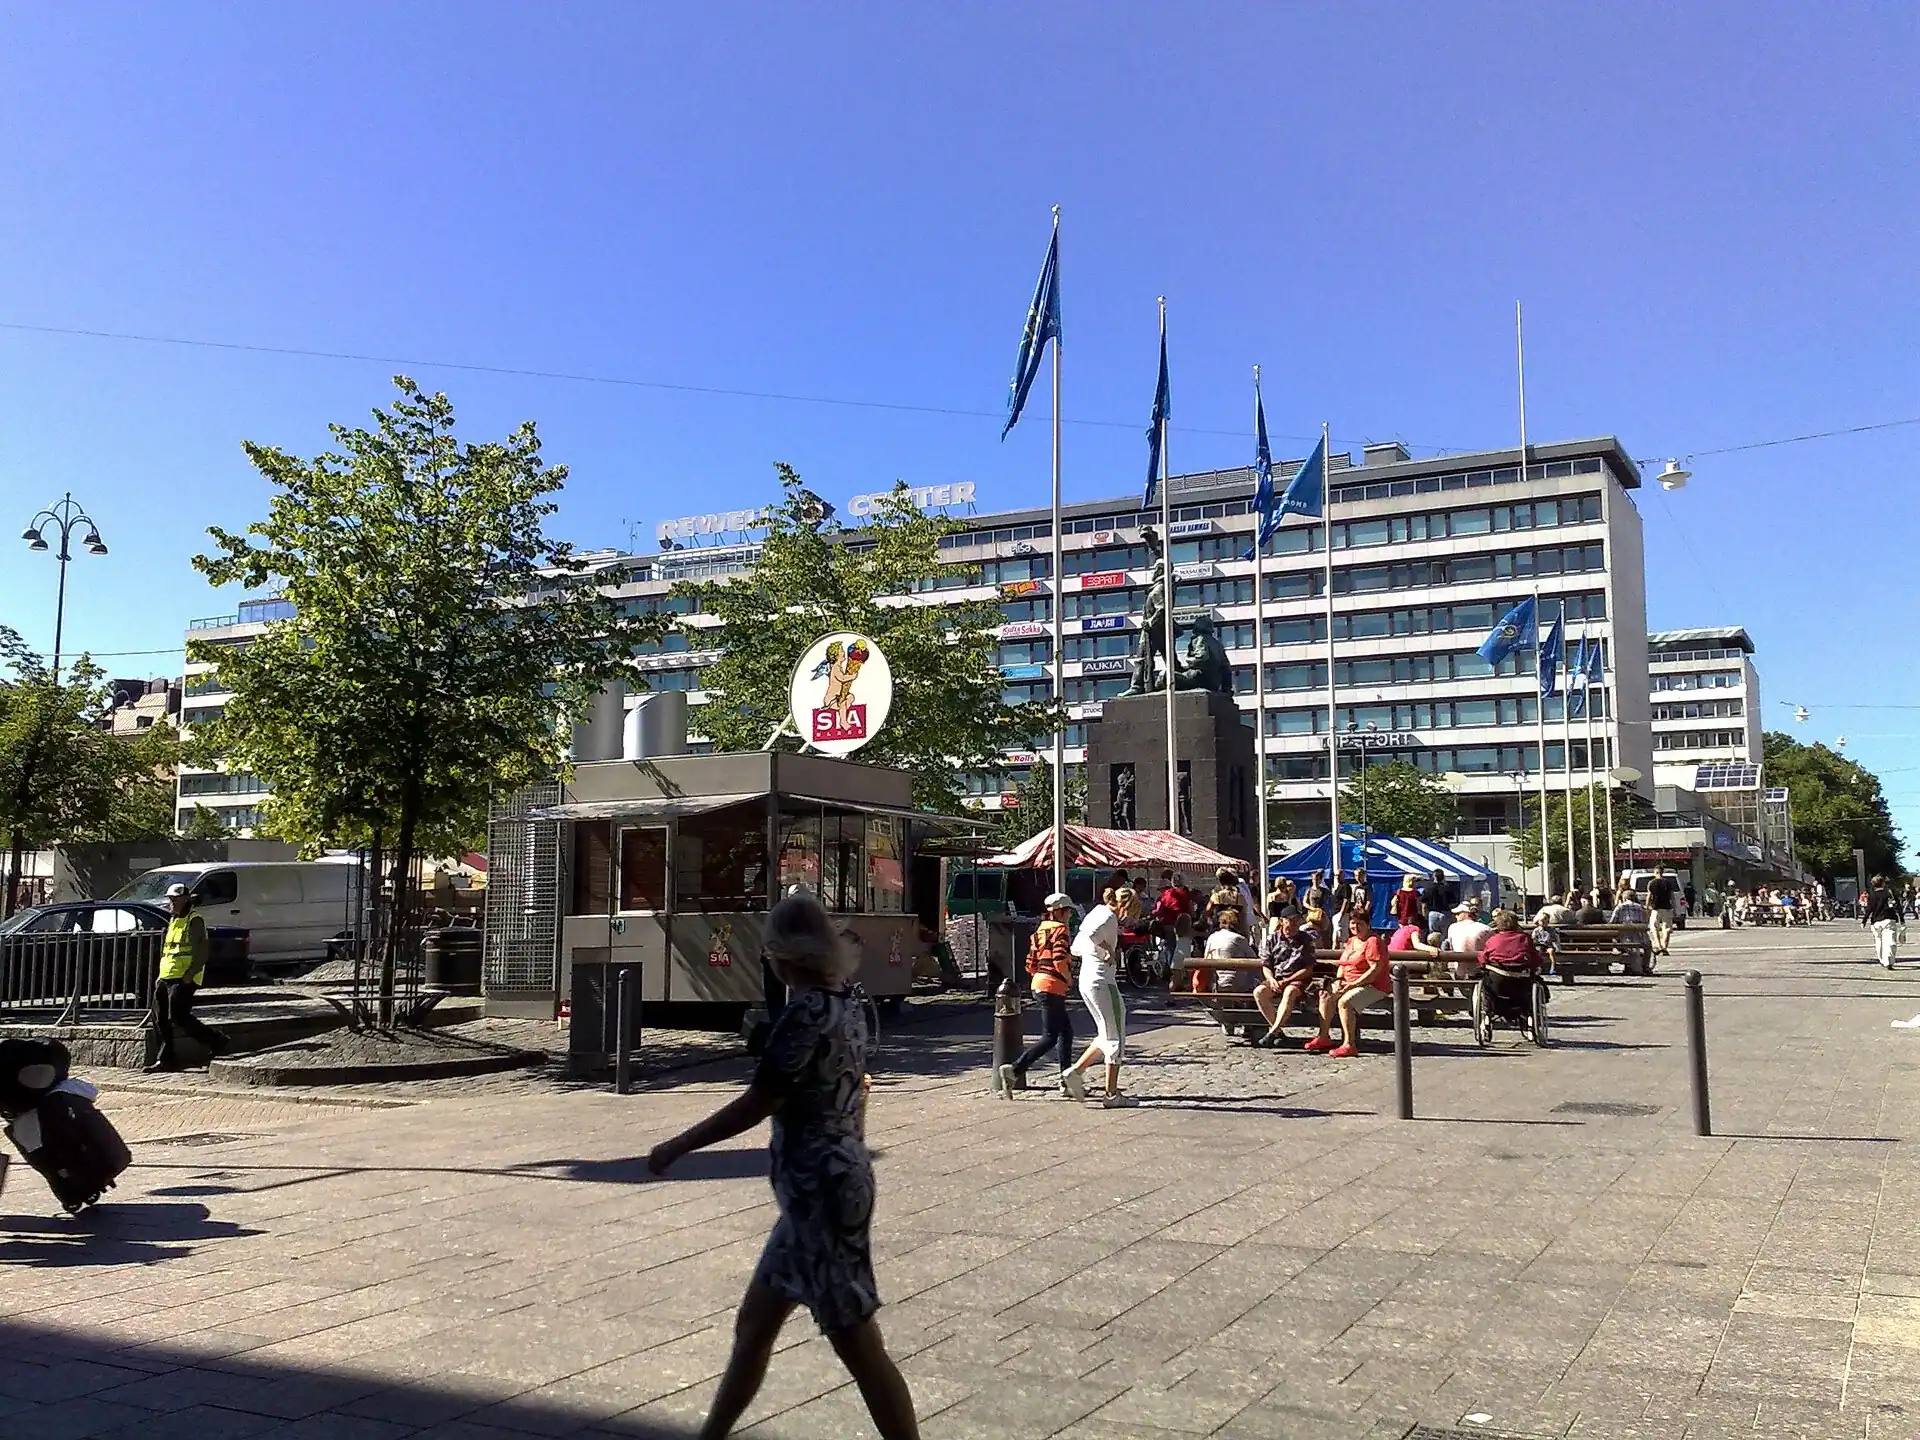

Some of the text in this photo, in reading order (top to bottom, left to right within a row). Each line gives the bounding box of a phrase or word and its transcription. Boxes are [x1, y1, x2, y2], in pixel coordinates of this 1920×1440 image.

[1087, 575, 1119, 586] ESPRIT
[1084, 661, 1122, 671] AUKIA
[816, 709, 862, 731] SIA
[710, 953, 729, 962] SIA
